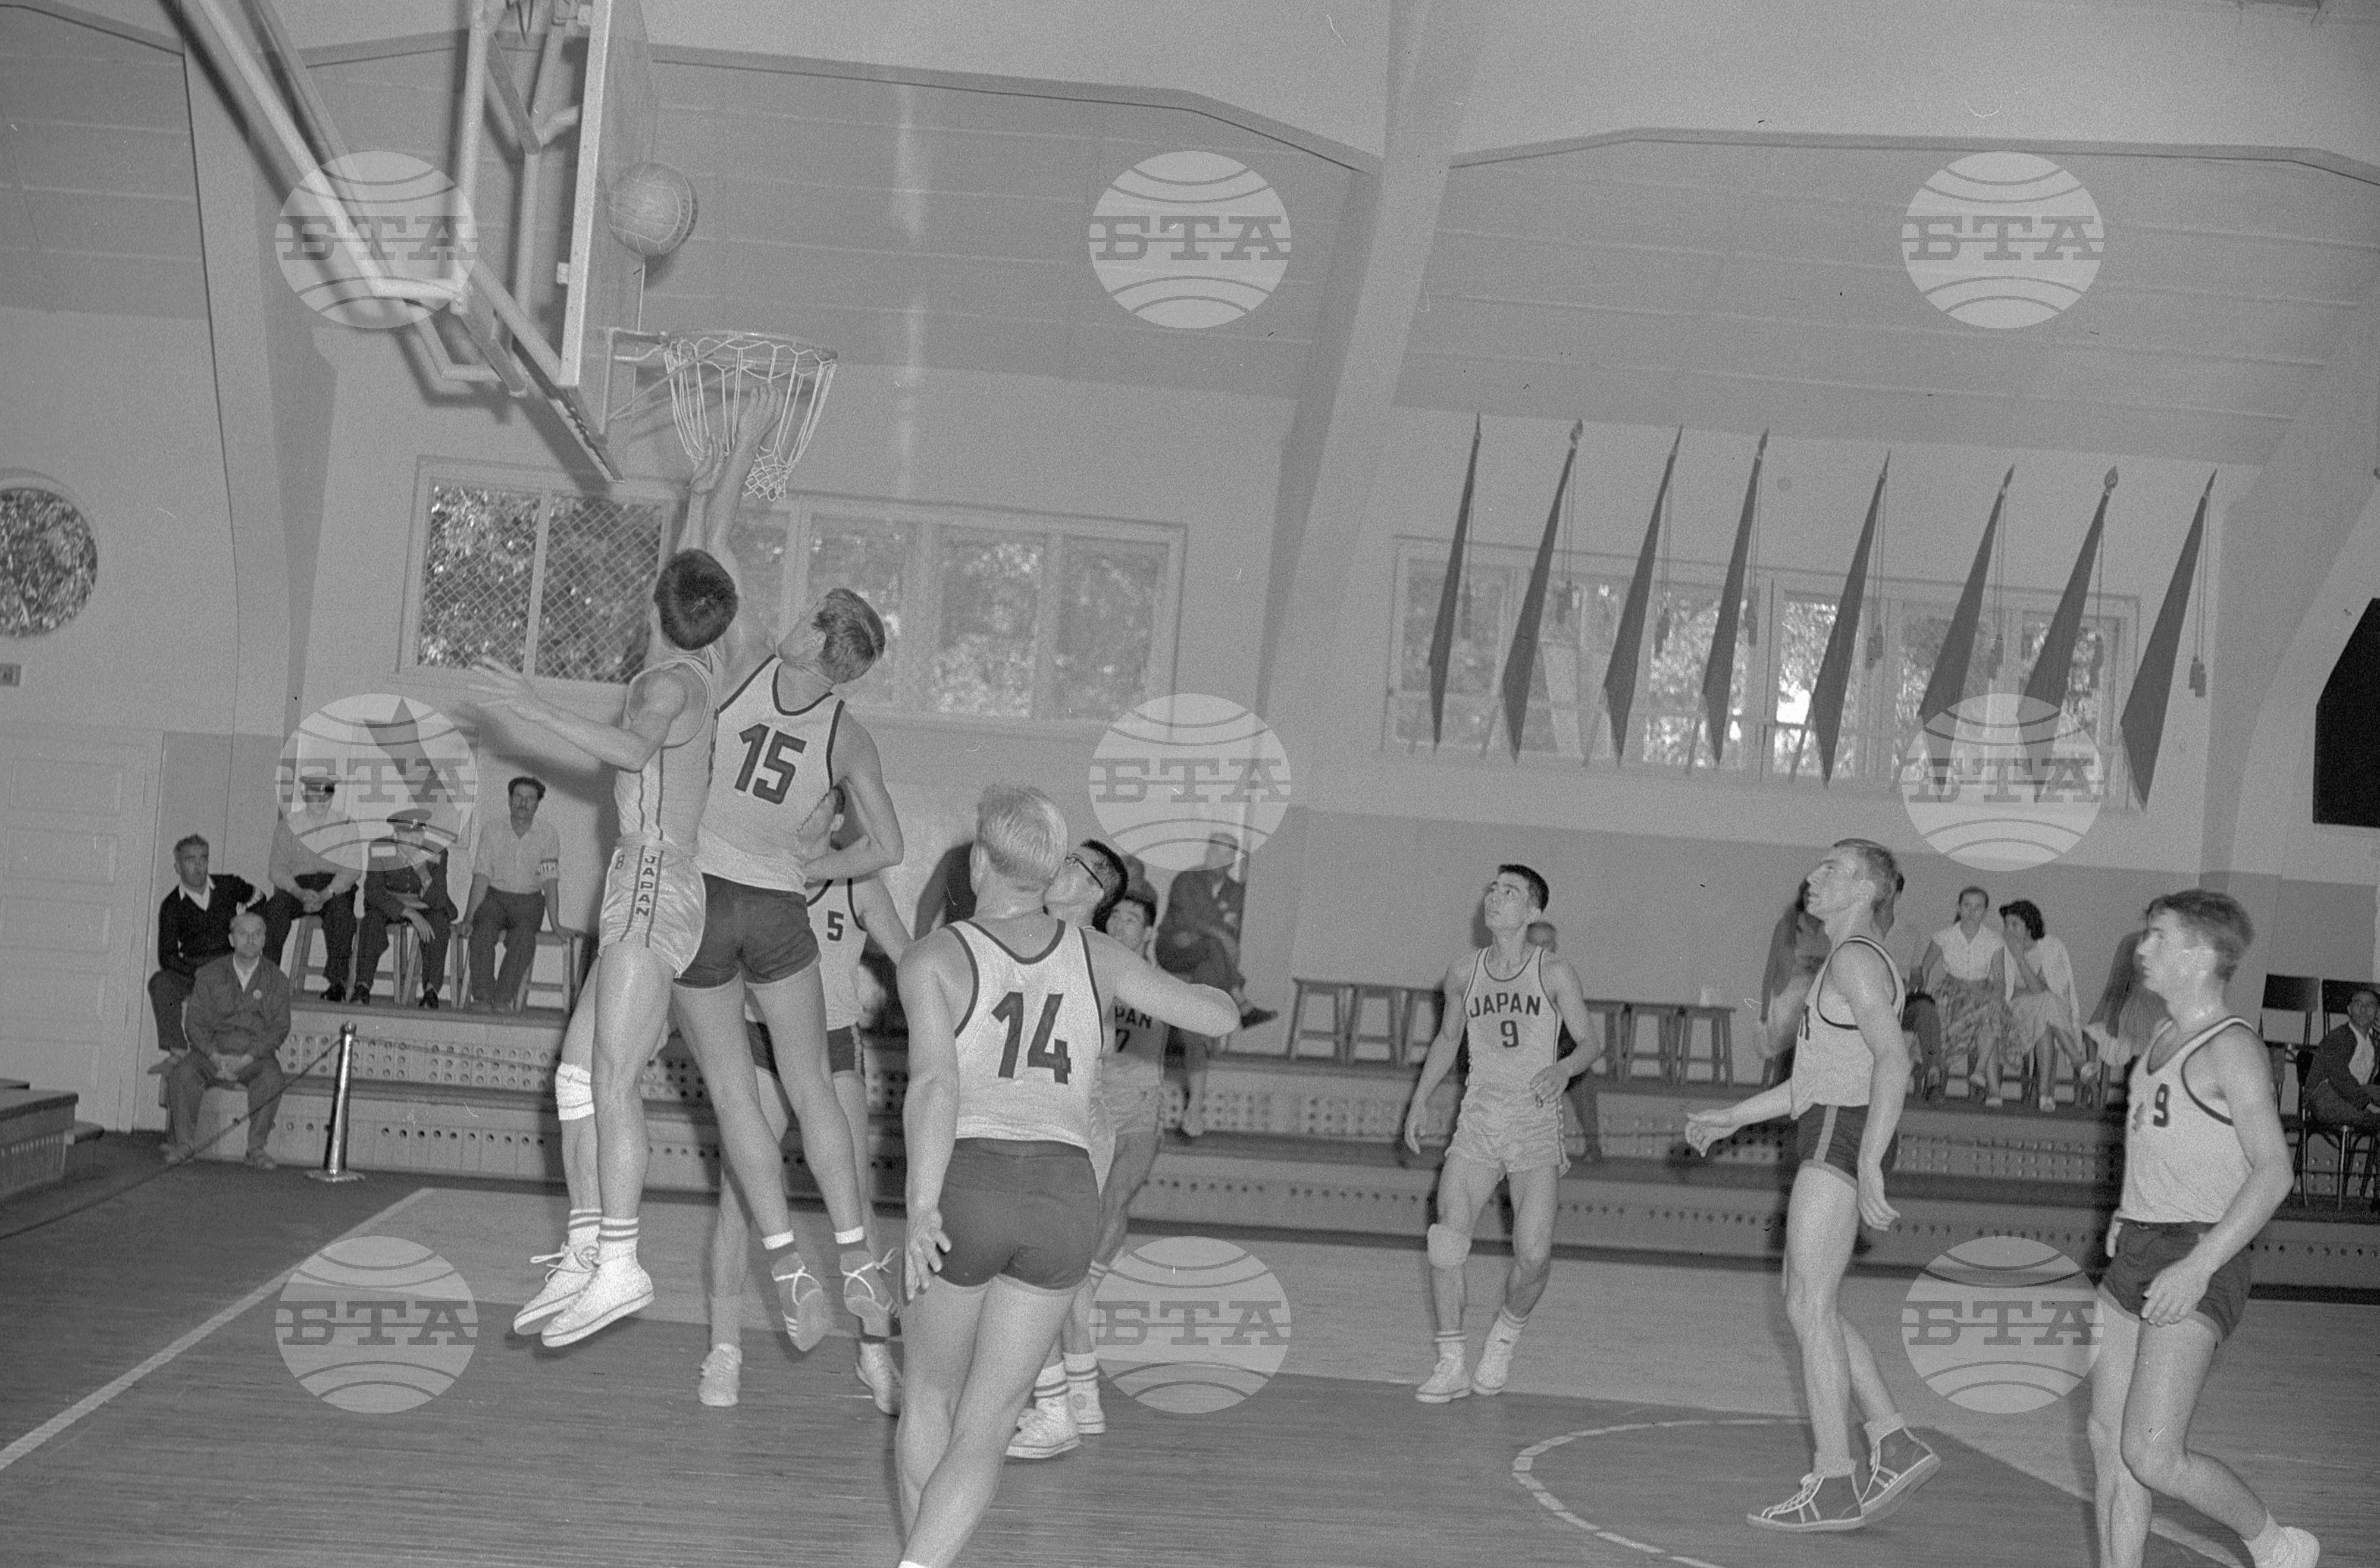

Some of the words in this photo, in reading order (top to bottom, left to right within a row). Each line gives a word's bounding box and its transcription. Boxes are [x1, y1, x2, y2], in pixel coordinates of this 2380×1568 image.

[734, 723, 807, 804] 15
[635, 855, 657, 917] JAPAN
[827, 910, 844, 941] 5
[1114, 1006, 1152, 1029] PAN
[1469, 992, 1541, 1018] JAPAN
[991, 992, 1071, 1084] 14
[1115, 1028, 1130, 1053] 7
[1500, 1020, 1519, 1048] 9
